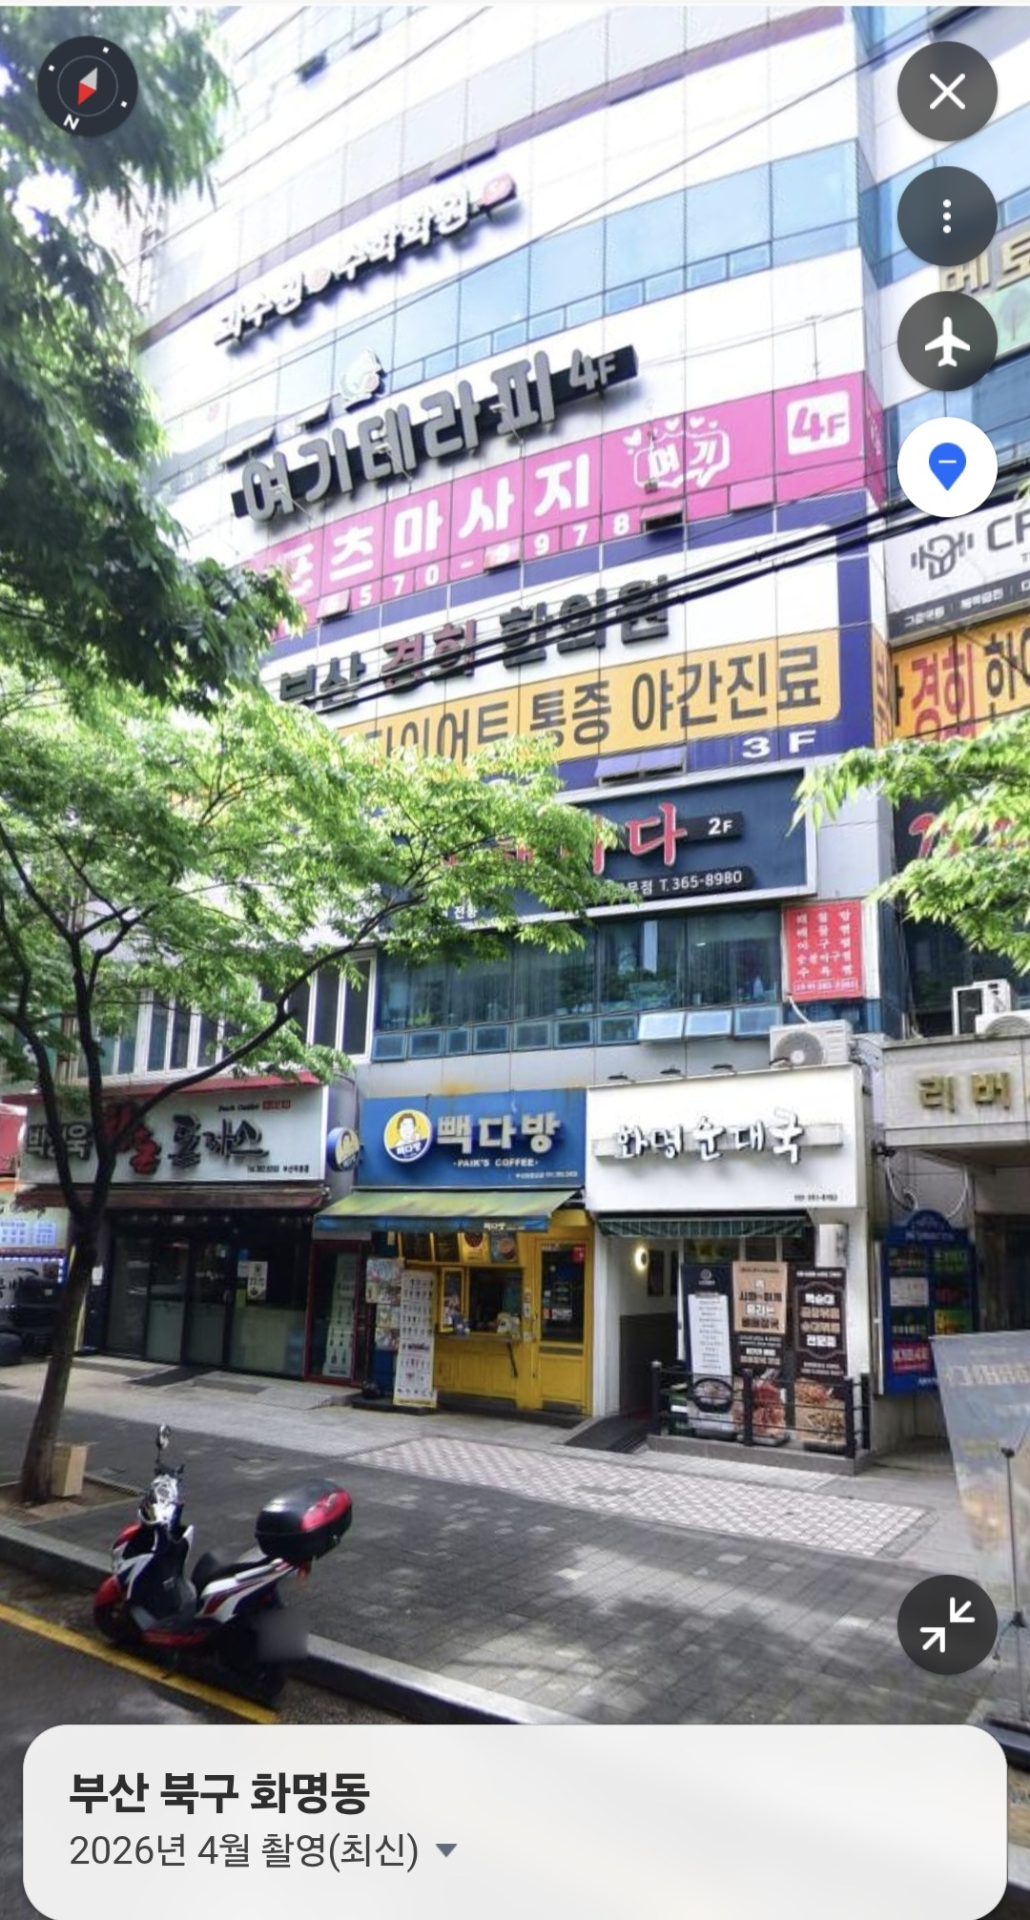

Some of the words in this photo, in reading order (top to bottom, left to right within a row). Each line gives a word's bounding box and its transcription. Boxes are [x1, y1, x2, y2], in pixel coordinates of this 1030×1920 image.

[242, 351, 556, 522] 여기테라피
[568, 349, 617, 391] 4F
[791, 405, 847, 442] 4F
[384, 618, 478, 690] 경희
[500, 574, 669, 669] 한의원
[530, 679, 612, 747] 통증
[632, 645, 821, 731] 야간진료
[911, 640, 977, 740] 경희
[708, 817, 734, 836] 2F
[660, 870, 743, 893] T.365-8980
[918, 1071, 1030, 1114] 리버
[437, 1112, 561, 1154] 빽다방
[457, 1159, 490, 1168] PAIK'S
[495, 1158, 535, 1167] COFFEE
